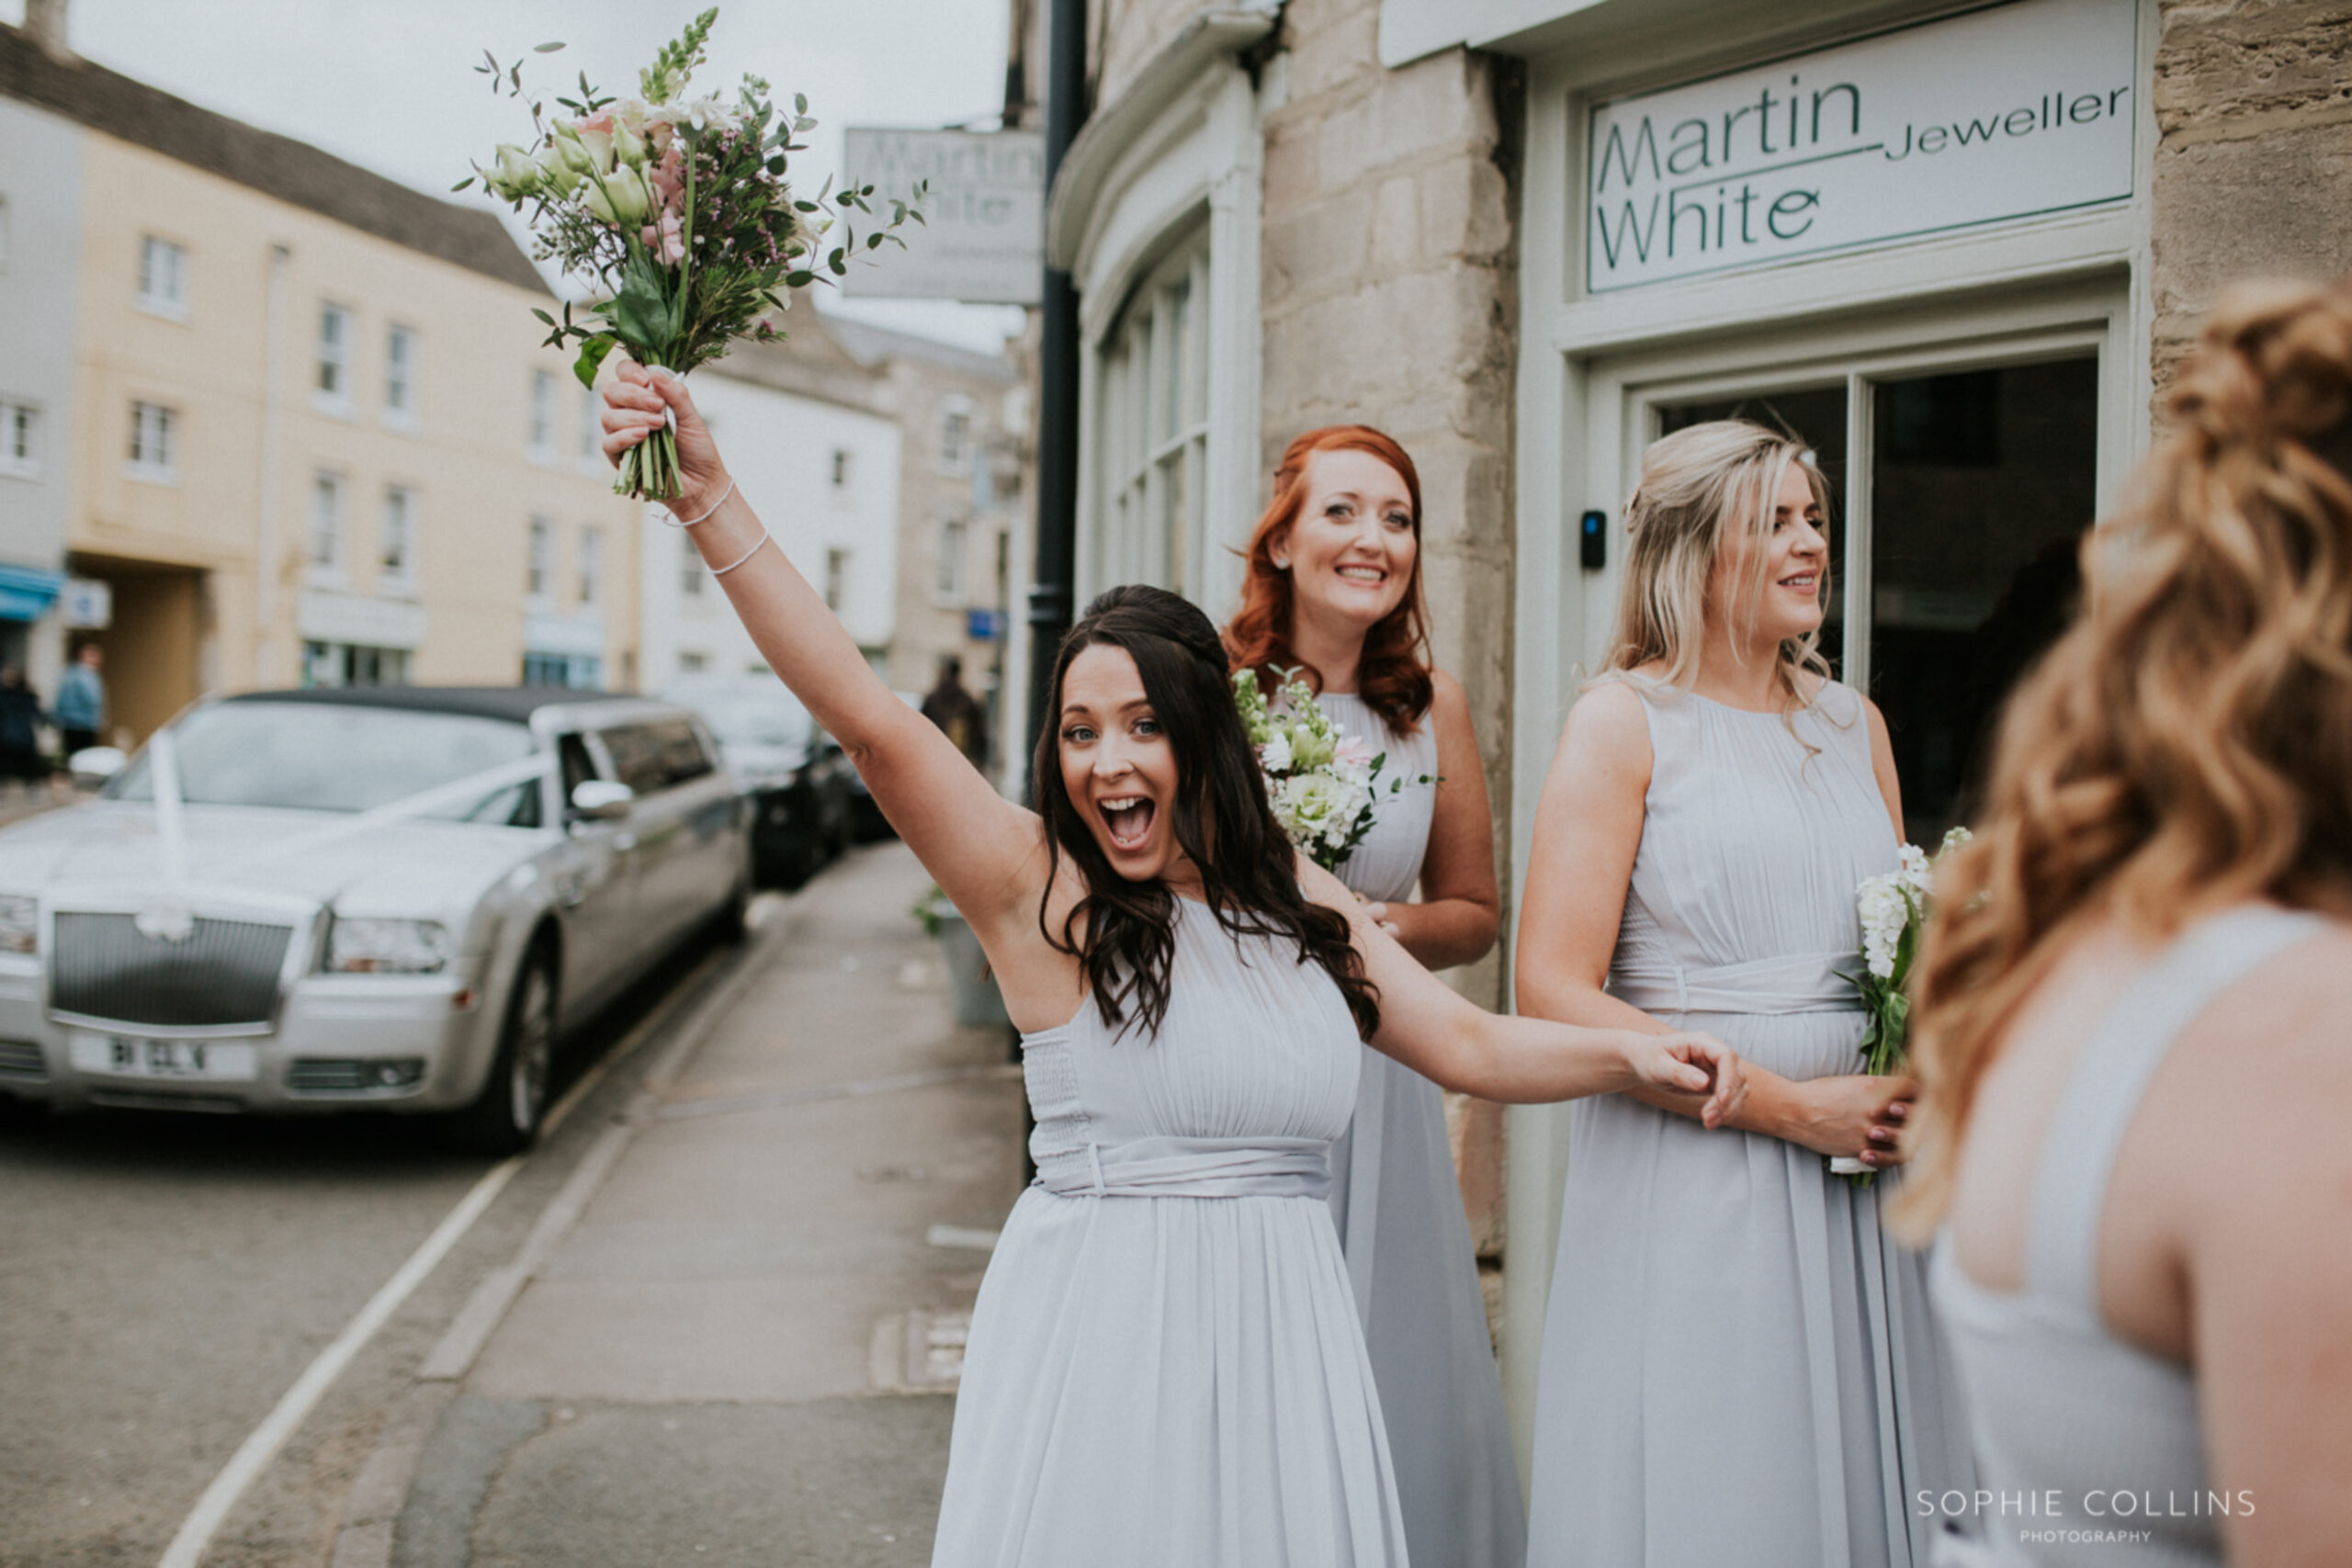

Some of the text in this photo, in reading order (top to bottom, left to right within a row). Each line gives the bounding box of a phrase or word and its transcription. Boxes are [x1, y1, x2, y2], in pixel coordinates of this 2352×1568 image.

[1598, 73, 1861, 193] Martin
[1884, 86, 2130, 161] Jeweller
[1597, 184, 1821, 270] White
